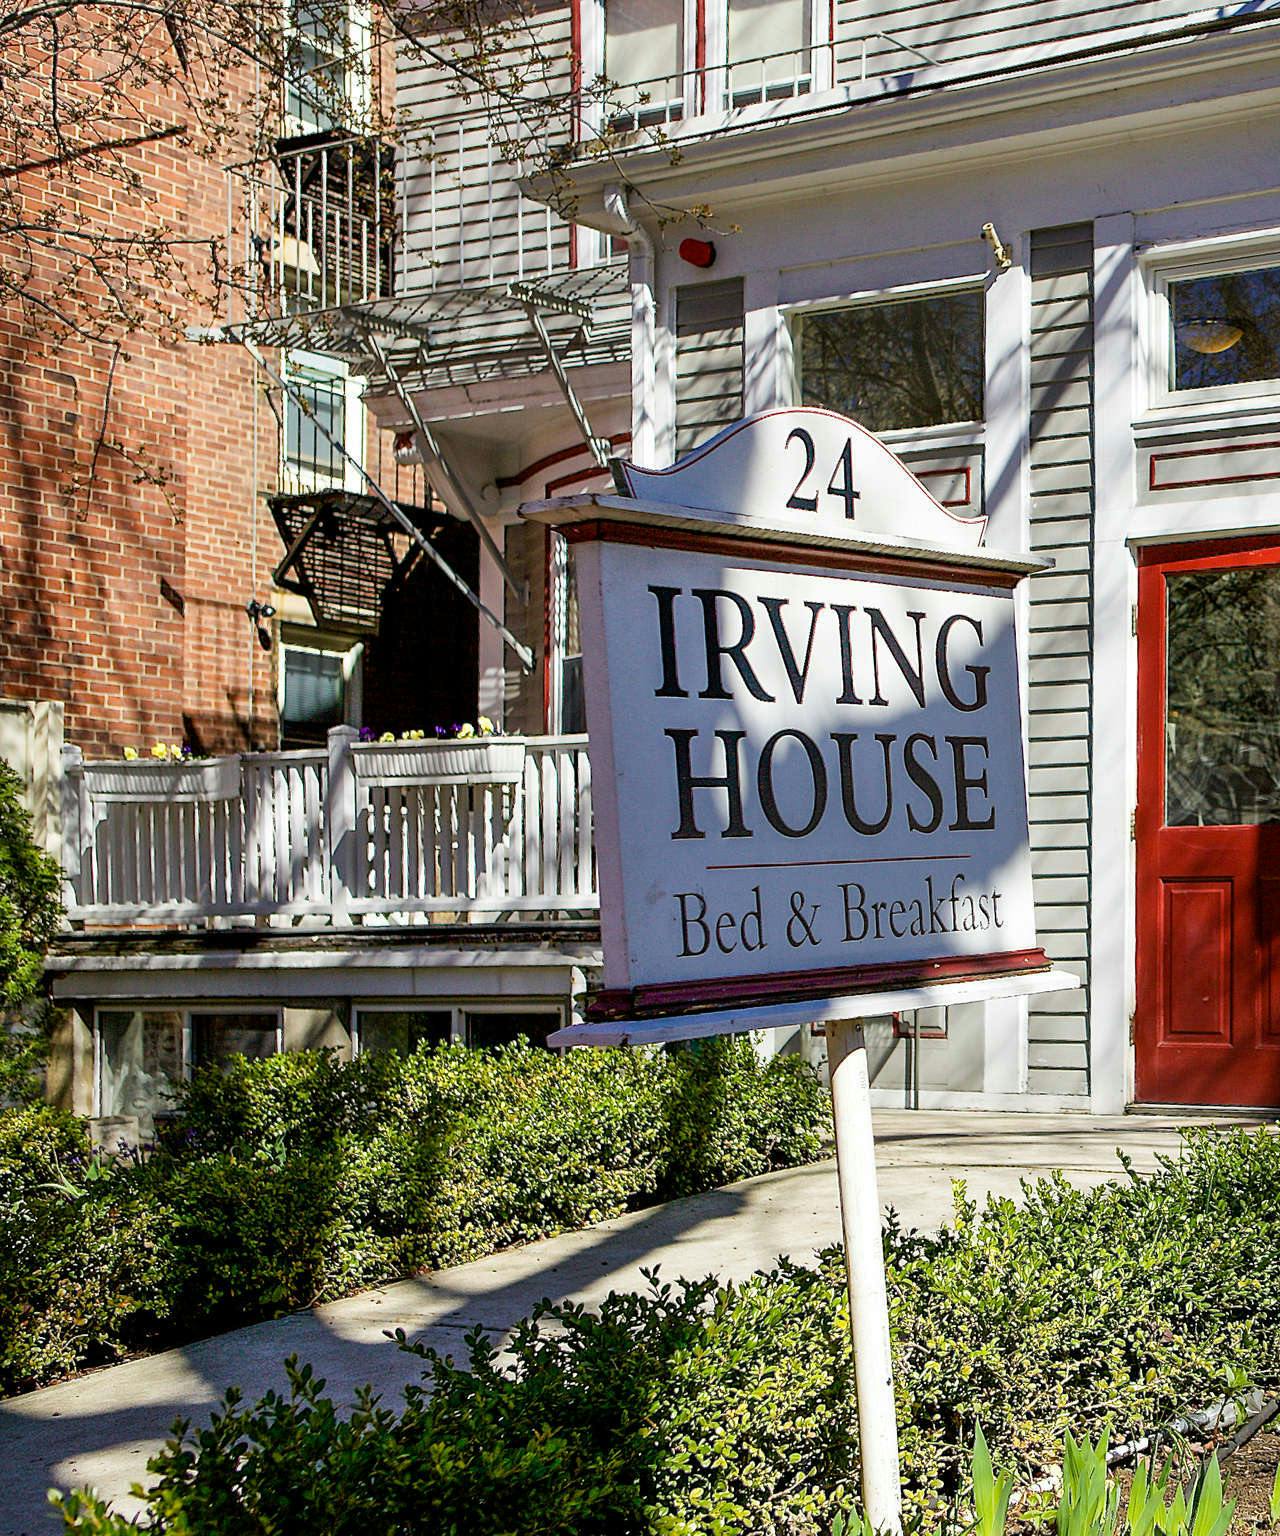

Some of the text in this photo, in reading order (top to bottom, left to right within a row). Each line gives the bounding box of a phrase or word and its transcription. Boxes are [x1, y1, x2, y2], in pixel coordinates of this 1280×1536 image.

[784, 427, 860, 520] 24
[648, 584, 991, 712] IRVING
[664, 728, 996, 840] HOUSE
[673, 873, 1005, 958] Bed & Breakfast
